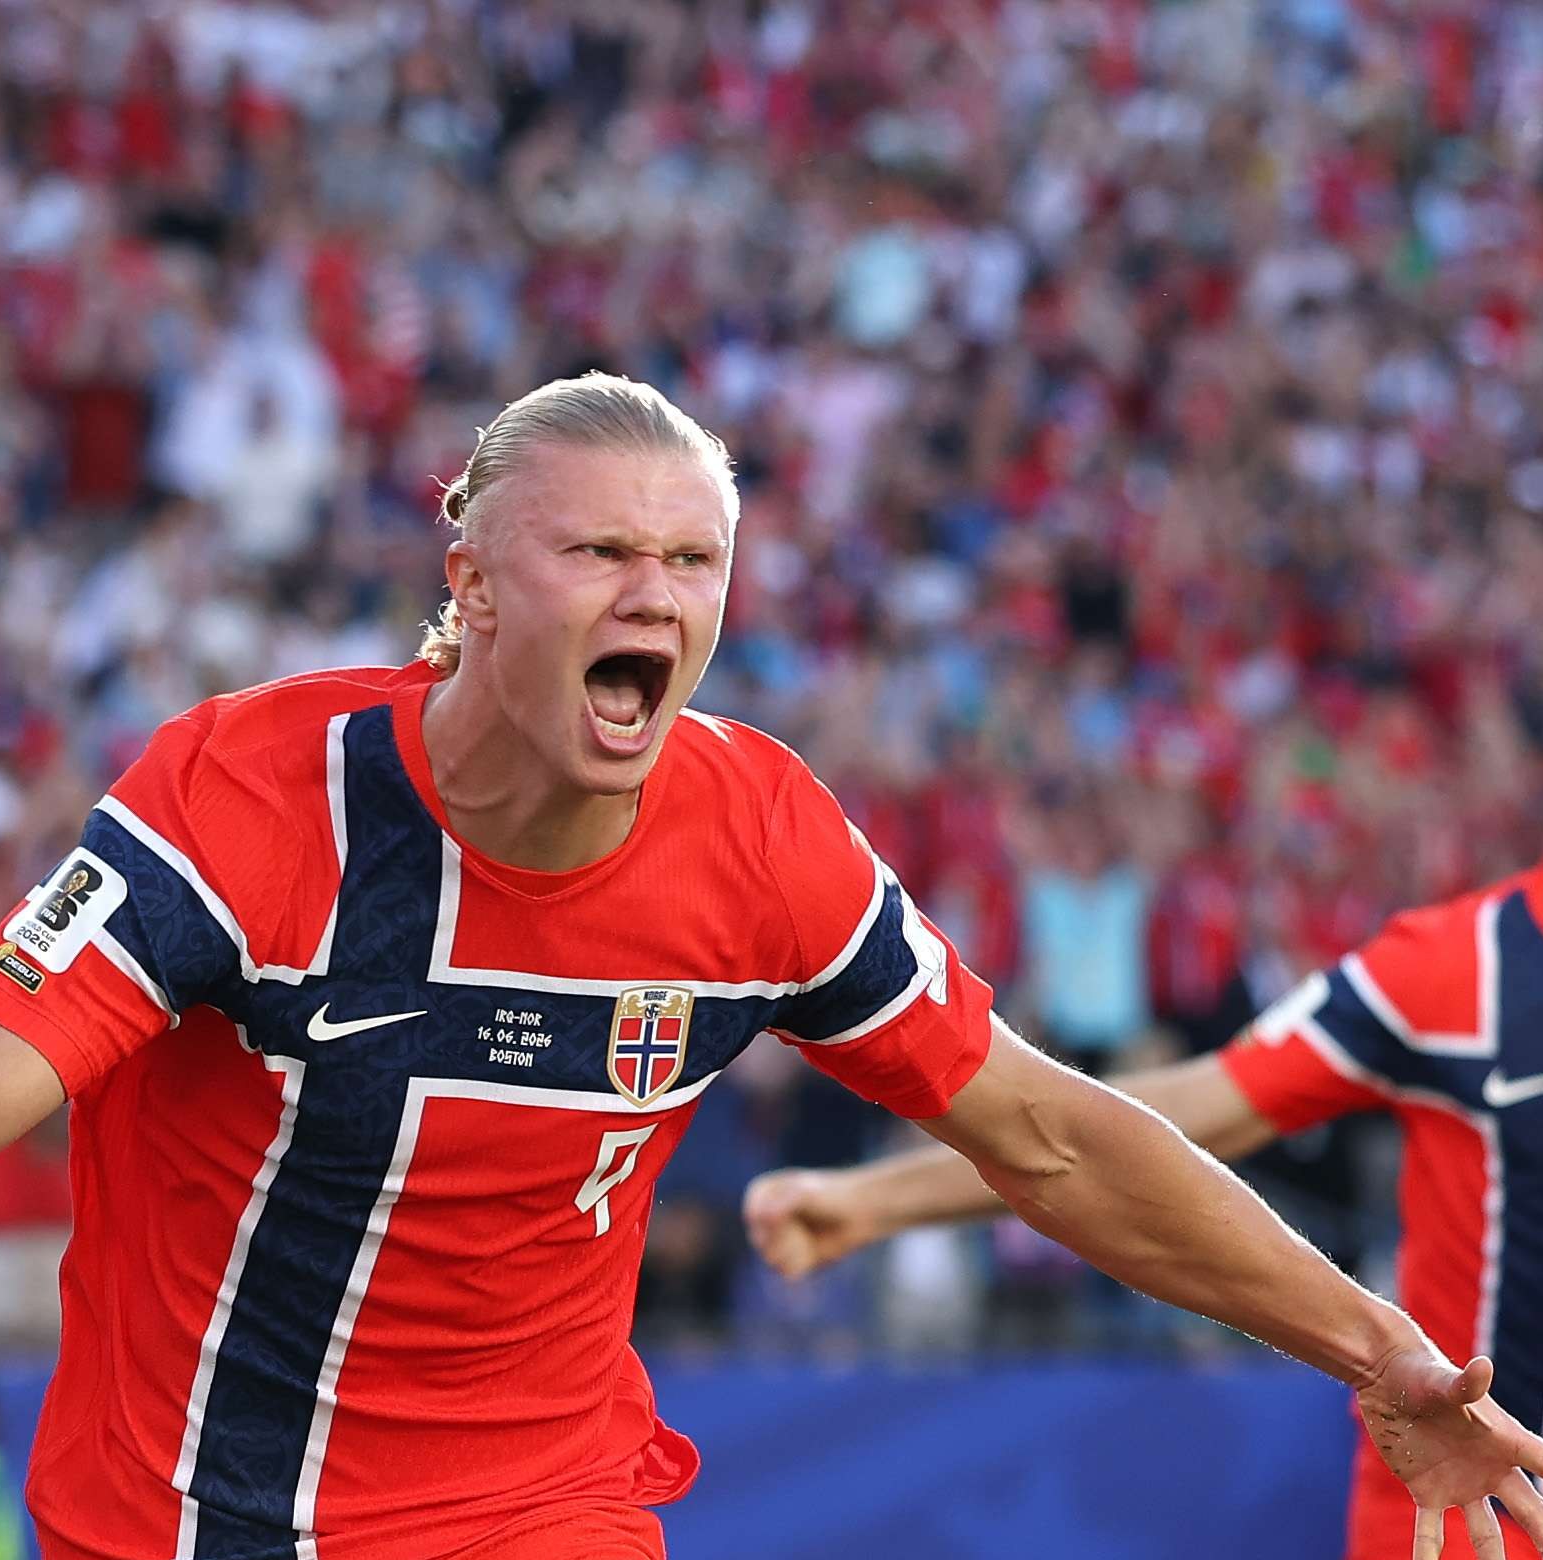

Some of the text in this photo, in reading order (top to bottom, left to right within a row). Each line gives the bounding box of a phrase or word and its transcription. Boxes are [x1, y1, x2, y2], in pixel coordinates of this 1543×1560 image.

[17, 926, 51, 953] 2026
[41, 930, 57, 943] CUP
[5, 956, 40, 982] DEBUT
[494, 1008, 543, 1027] IRQ-NOR
[488, 1047, 534, 1068] BOSTON
[574, 1122, 659, 1238] 9
